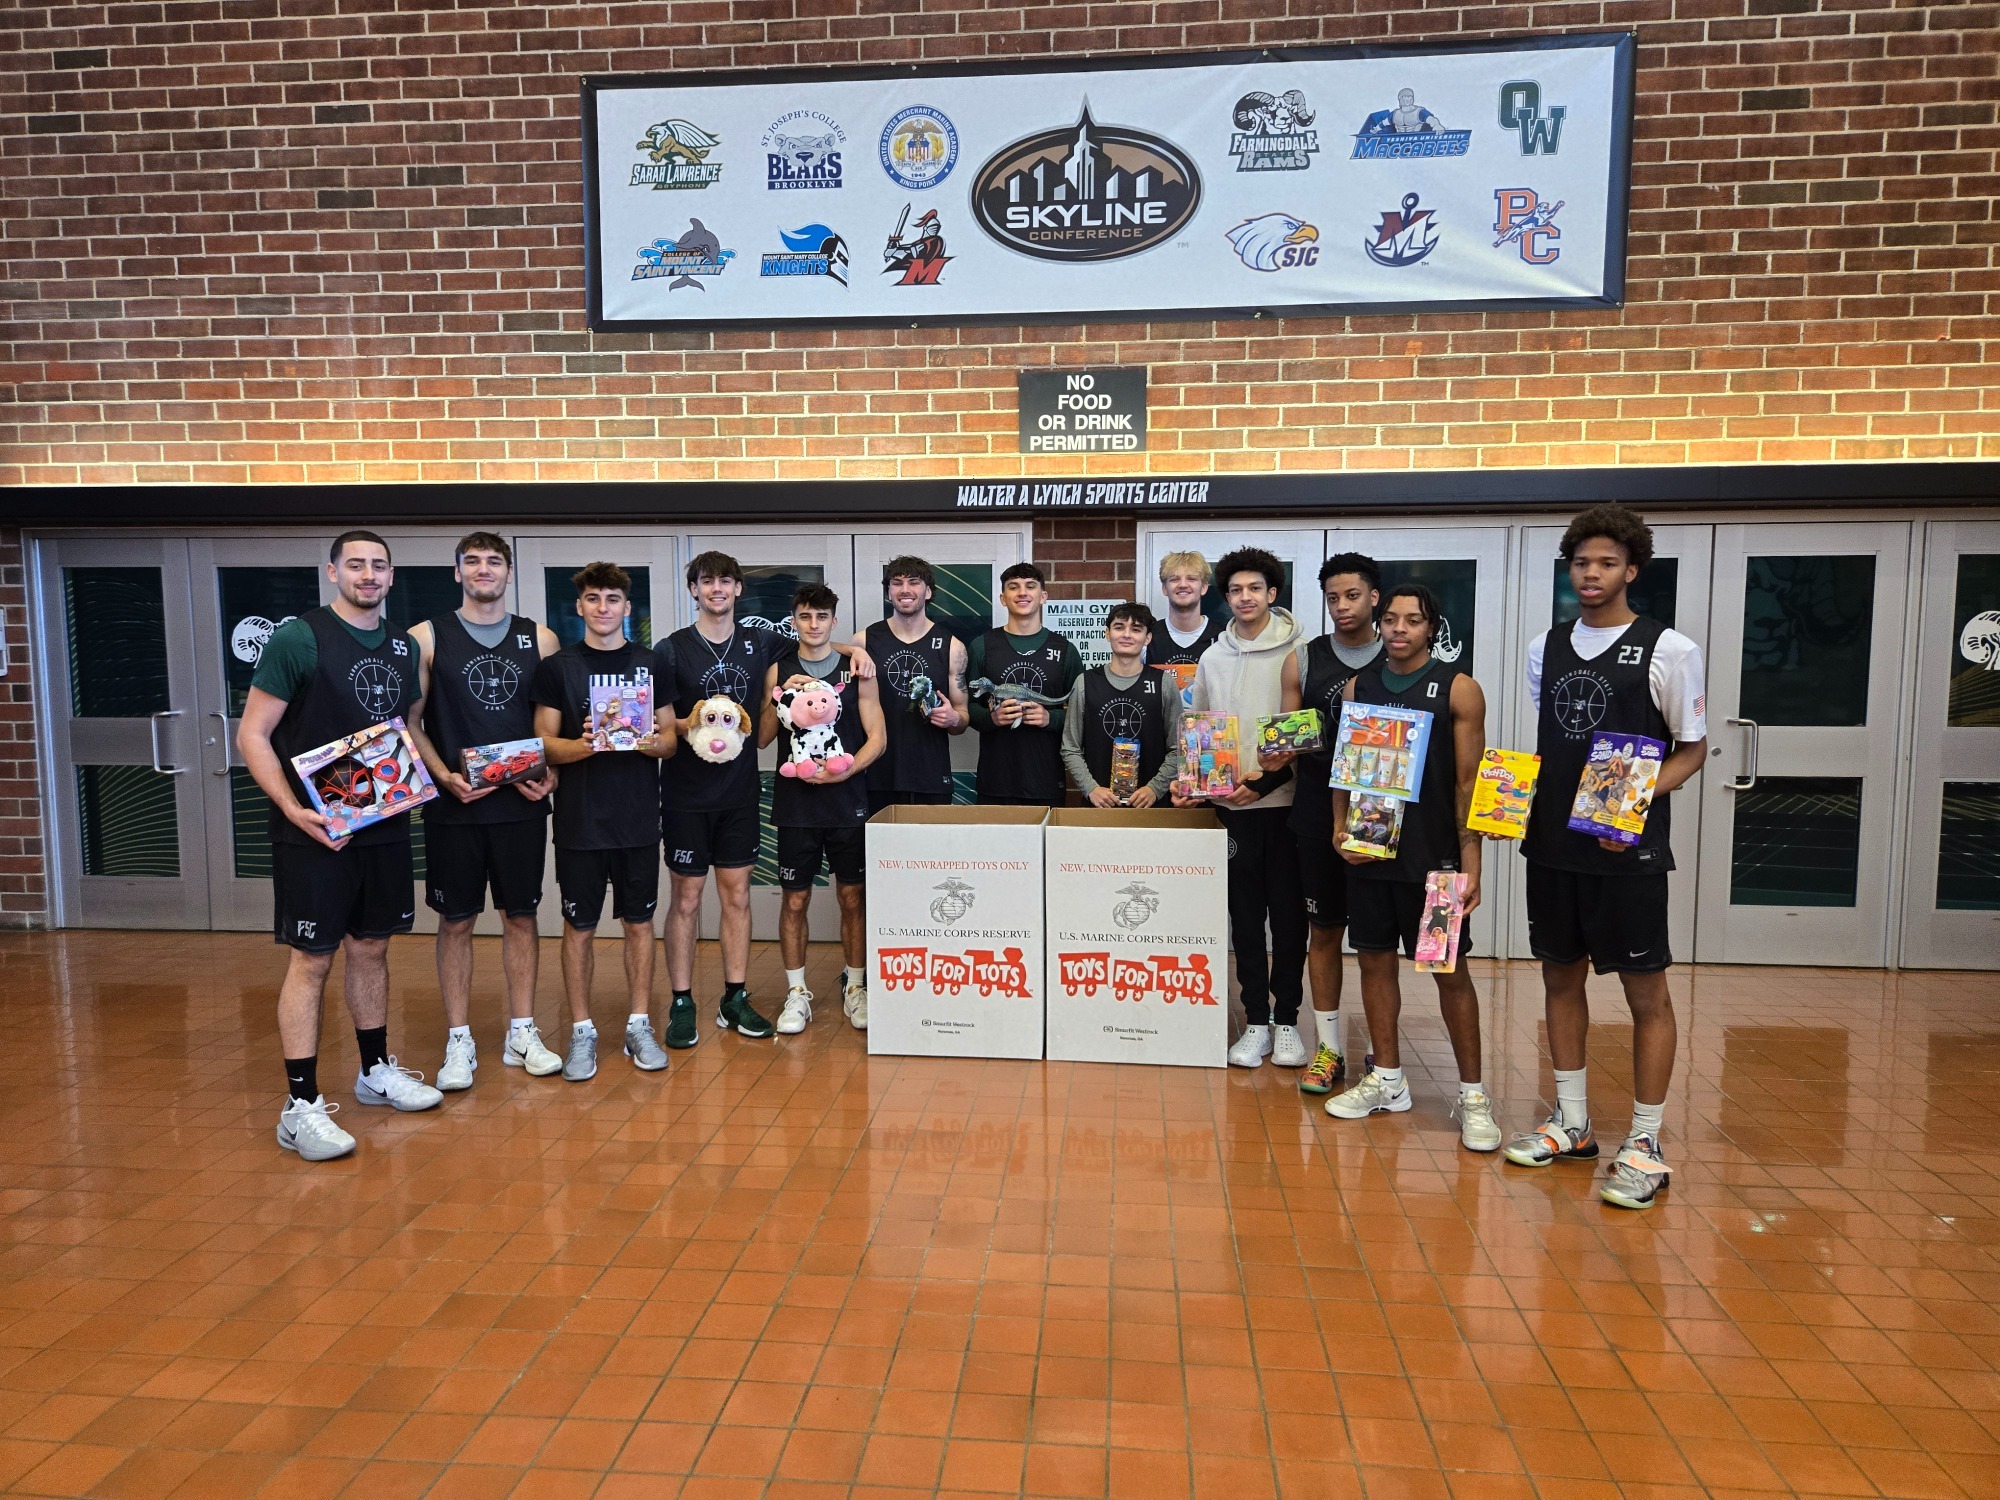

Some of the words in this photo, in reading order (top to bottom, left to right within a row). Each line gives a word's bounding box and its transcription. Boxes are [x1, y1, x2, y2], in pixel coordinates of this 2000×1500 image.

[760, 134, 771, 147] ST.
[771, 110, 809, 134] JOSEPH'S
[811, 111, 847, 144] COLLEGE
[883, 118, 898, 140] STATES
[897, 108, 931, 120] MERCHANT
[932, 111, 952, 131] MARINE
[1232, 133, 1317, 154] FARMINGDALE
[1354, 137, 1469, 158] MACCABEES
[768, 152, 842, 180] BEARS
[1240, 151, 1308, 171] RAMS
[632, 164, 666, 184] SARAH
[666, 164, 719, 183] LAWRENCE
[774, 180, 836, 189] BROOKLYN
[900, 178, 917, 188] KINGS
[919, 178, 936, 188] POINT
[1006, 202, 1167, 229] SKYLINE
[1029, 228, 1143, 241] CONFERENCE
[661, 257, 703, 265] MOUNT
[1281, 246, 1320, 267] SJC
[634, 265, 671, 280] SAINT
[672, 264, 723, 276] VINCENT
[762, 260, 828, 275] KNIGHTS
[1066, 375, 1094, 390] NO
[1058, 394, 1112, 410] FOOD
[1038, 414, 1066, 430] OR
[1075, 414, 1132, 430] DRINK
[1030, 434, 1138, 450] PERMITTED
[957, 485, 1016, 506] WALTER
[1018, 485, 1029, 505] A
[1033, 483, 1084, 505] LYNCH
[1085, 483, 1145, 504] SPORTS
[1148, 481, 1209, 504] CENTER
[1048, 605, 1084, 614] MAIN
[1058, 618, 1094, 626] RESERVED
[1096, 617, 1108, 626] FO
[516, 635, 532, 649] 15
[1076, 630, 1106, 639] PRACTIC
[392, 638, 408, 656] 55
[744, 640, 753, 654] 5
[931, 637, 942, 650] 13
[1080, 642, 1089, 650] OR
[1046, 648, 1061, 662] 34
[1617, 645, 1644, 664] 23
[348, 658, 384, 681] FARMINGDALE
[506, 659, 522, 674] STATE
[840, 670, 851, 683] 10
[1550, 669, 1597, 694] FARMINGDALE
[1598, 676, 1614, 696] STATE
[1144, 680, 1155, 694] 31
[1426, 682, 1438, 698] 0
[1343, 704, 1370, 718] BLUEY
[674, 849, 694, 864] FSC
[878, 860, 904, 870] NEW,
[906, 860, 969, 870] UNWRAPPED
[971, 862, 998, 870] TOYS
[1000, 862, 1029, 870] ONLY
[1060, 863, 1086, 873] NEW,
[1088, 864, 1153, 874] UNWRAPPED
[1155, 866, 1183, 875] TOYS
[1185, 866, 1215, 875] ONLY
[780, 866, 796, 880] FSC
[1305, 898, 1318, 914] SC
[297, 921, 316, 939] FSC
[878, 928, 897, 936] U.S.
[899, 928, 942, 937] MARINE
[944, 929, 979, 938] CORPS
[982, 930, 1031, 939] RESERVE
[1059, 932, 1078, 941] U.S.
[1080, 933, 1125, 942] MARINE
[1126, 935, 1164, 944] CORPS
[1167, 936, 1217, 944] RESERVE
[1418, 942, 1438, 951] Barbie
[882, 953, 924, 976] TOYS
[932, 960, 964, 982] FOR
[976, 962, 1020, 987] TOTS
[1062, 957, 1106, 981] TOYS
[1115, 965, 1147, 987] FOR
[1160, 968, 1206, 994] TOTS
